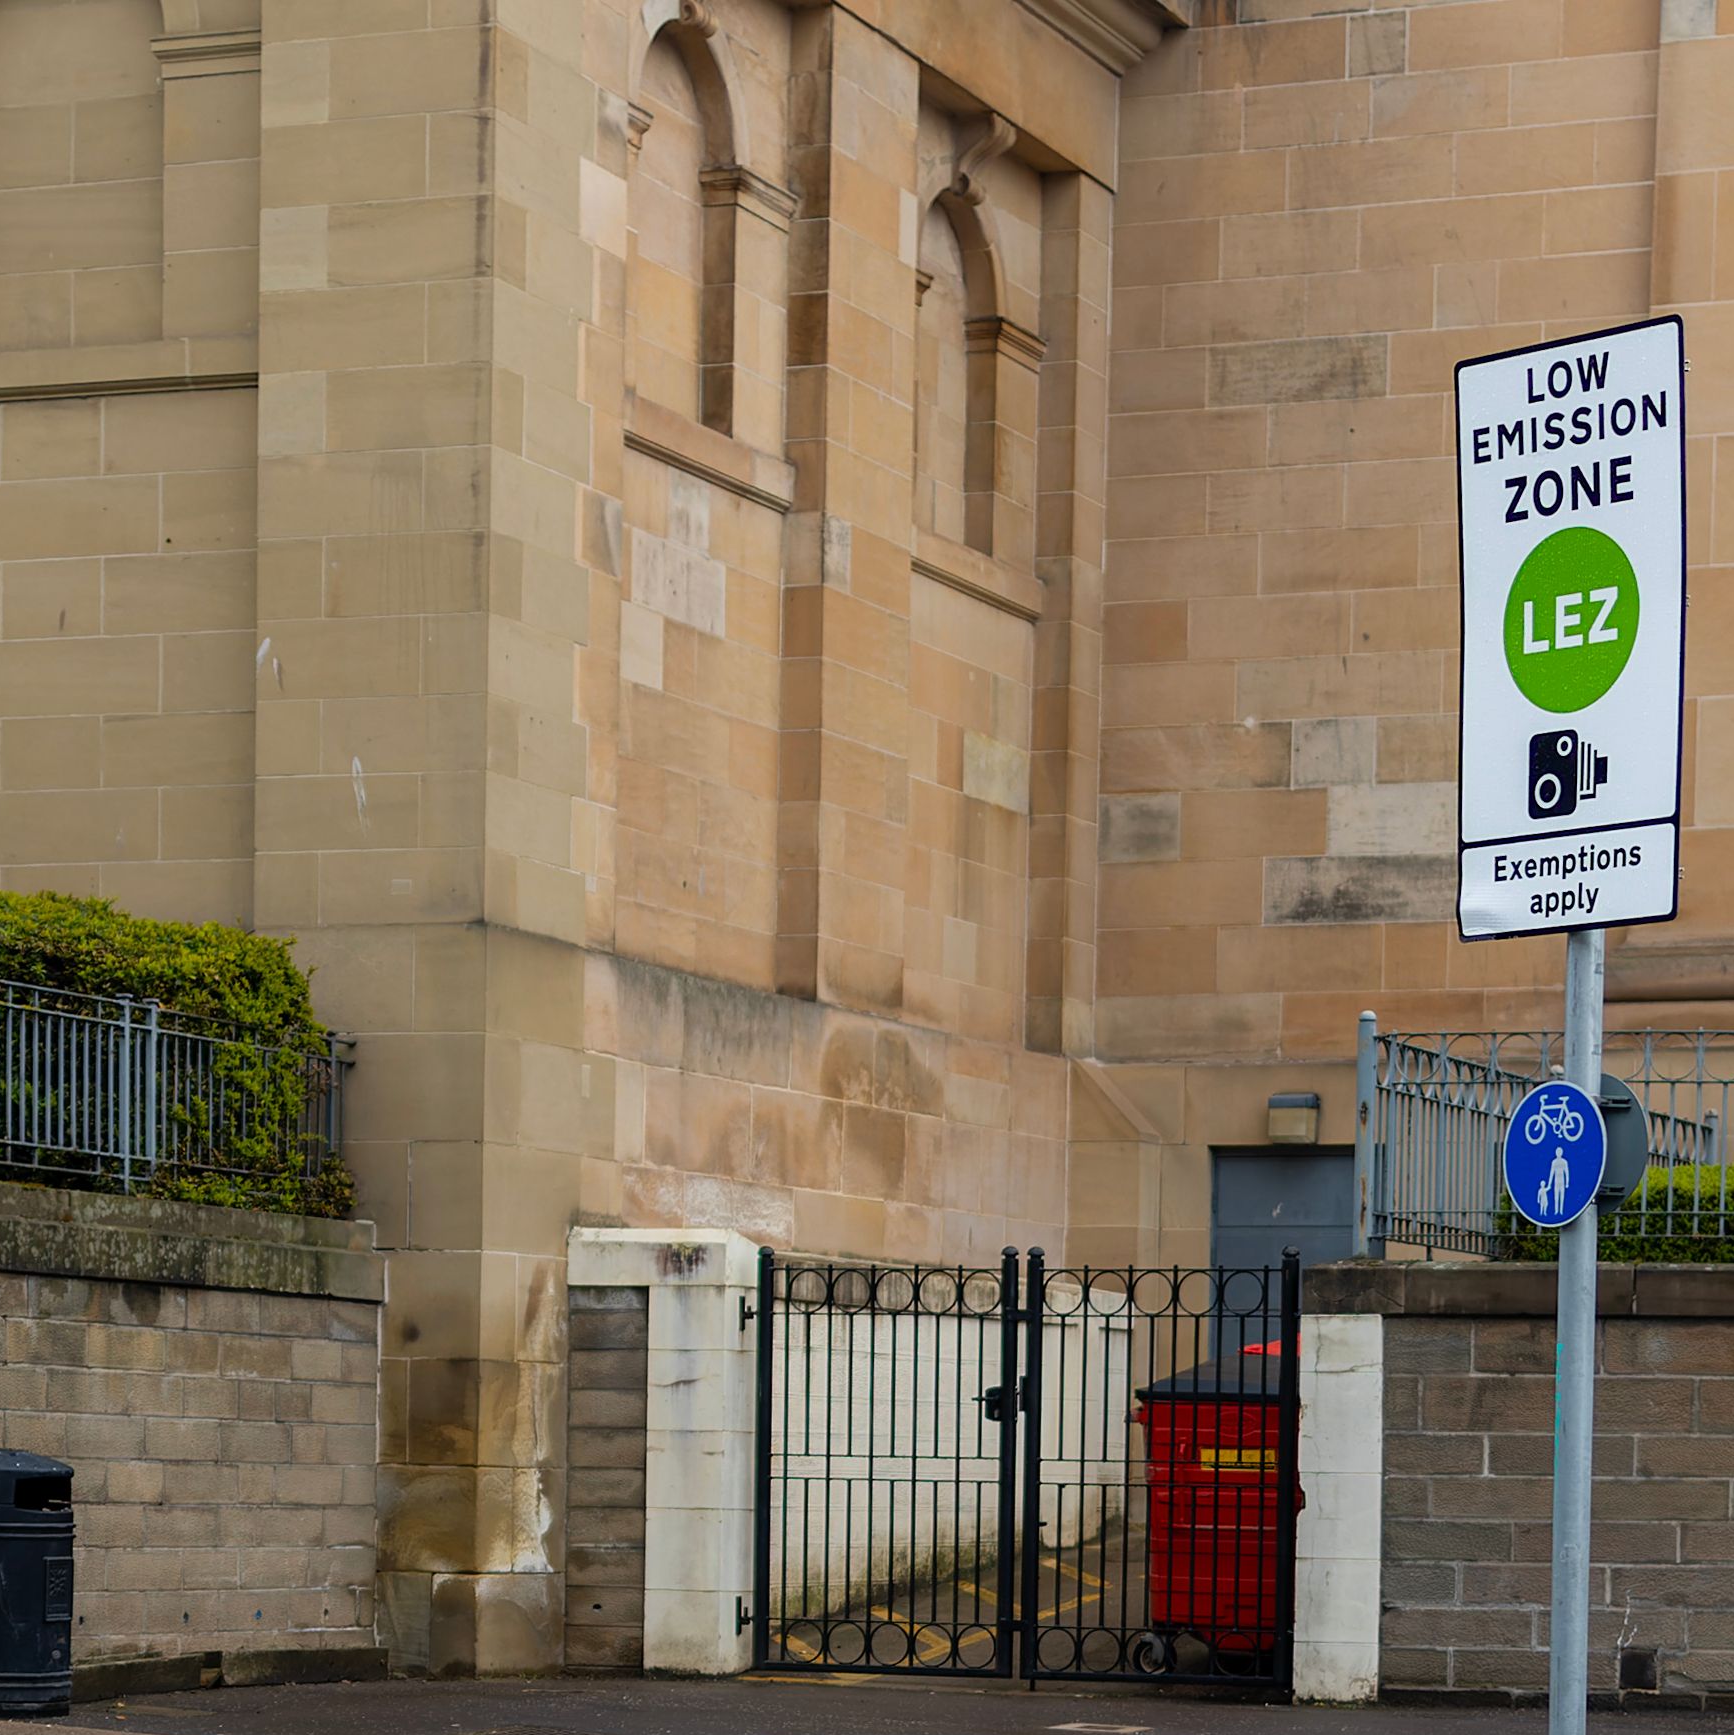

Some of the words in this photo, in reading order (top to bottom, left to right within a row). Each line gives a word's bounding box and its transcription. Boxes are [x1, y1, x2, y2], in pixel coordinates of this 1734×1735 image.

[1527, 351, 1610, 404] LOW
[1472, 391, 1669, 464] EMISSION
[1504, 455, 1635, 524] ZONE
[1521, 586, 1619, 655] LEZ
[1493, 842, 1643, 888] Exemptions
[1529, 877, 1600, 917] apply
